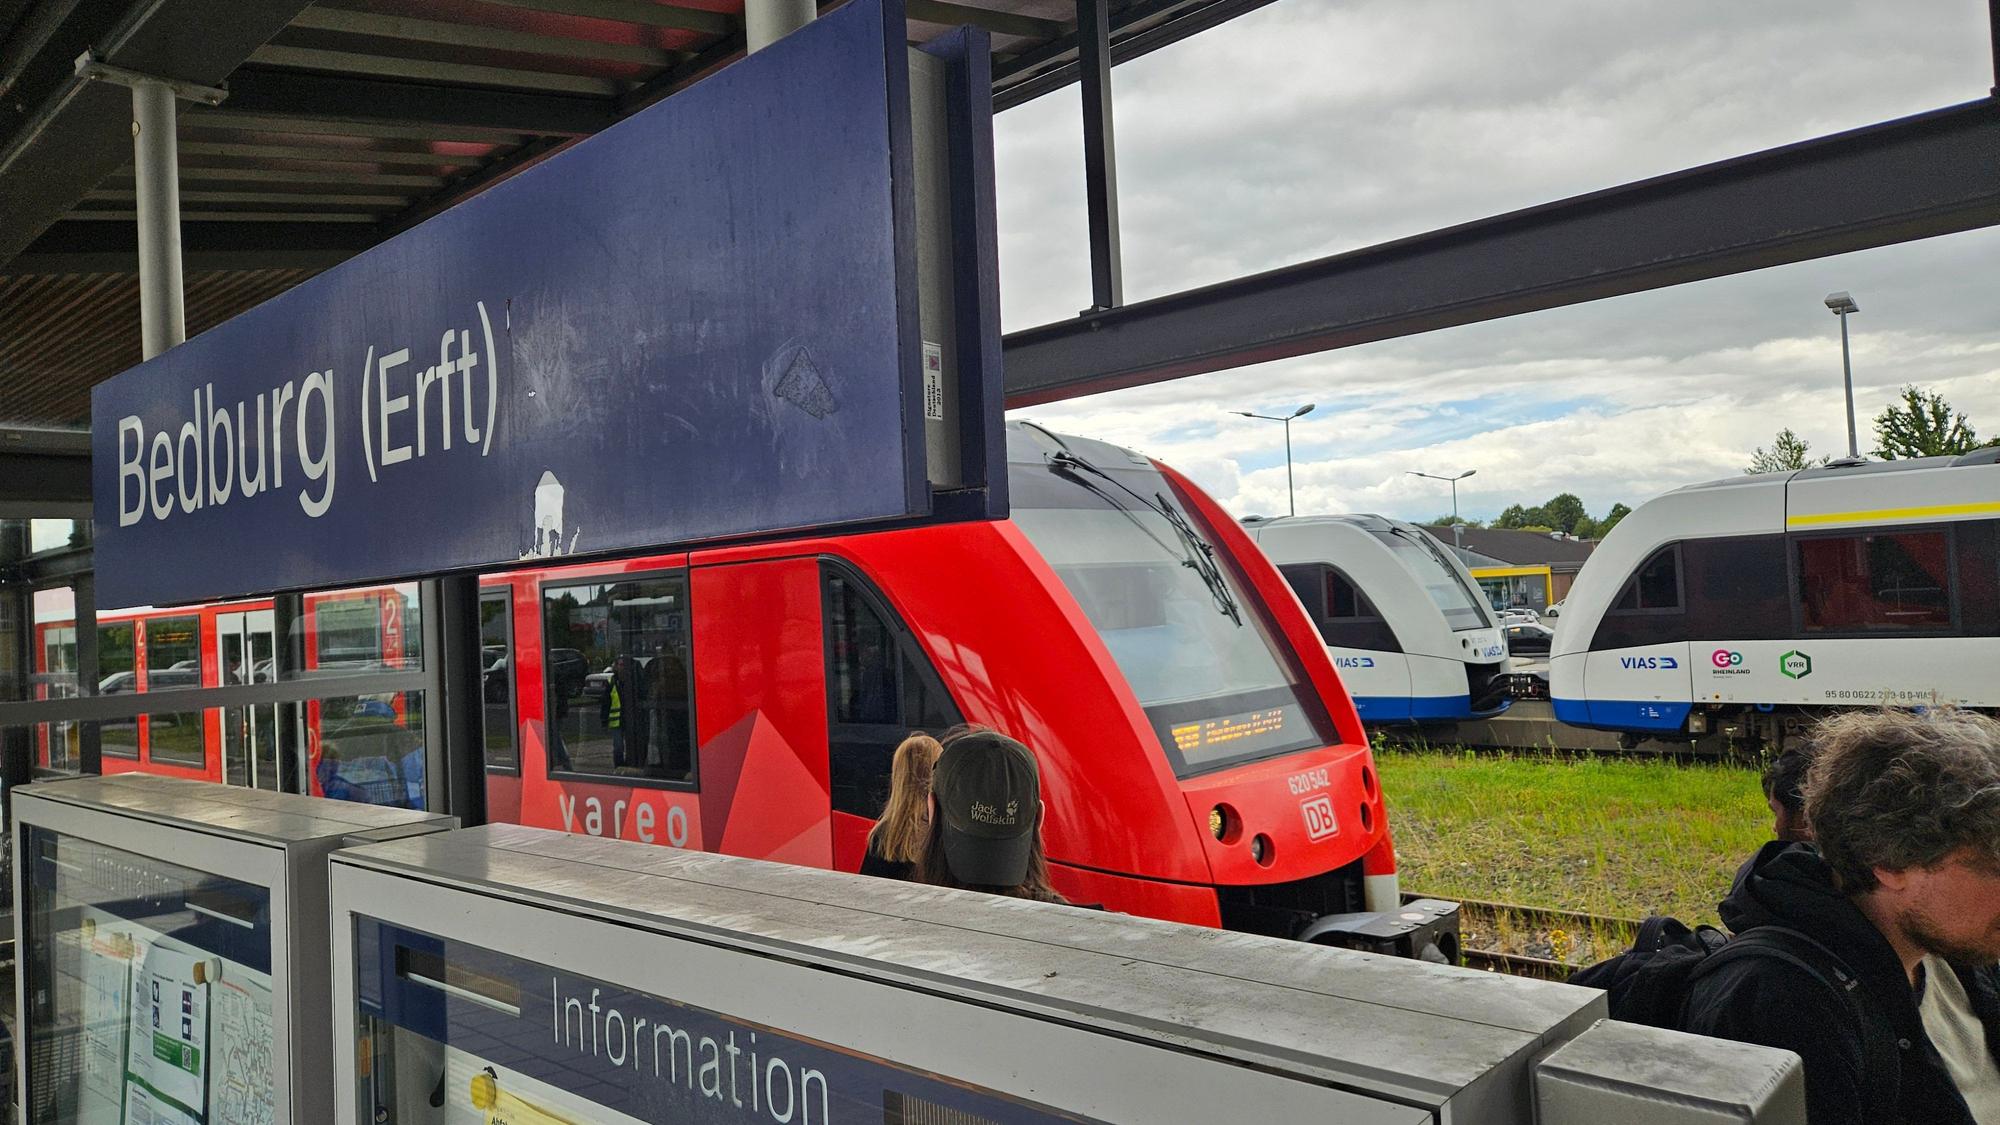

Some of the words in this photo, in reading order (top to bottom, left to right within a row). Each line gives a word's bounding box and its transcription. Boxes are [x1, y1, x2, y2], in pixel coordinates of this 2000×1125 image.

[118, 369, 336, 528] Bedburg
[361, 301, 498, 483] (Erft)
[385, 598, 398, 634] 2
[136, 620, 144, 646] 2
[1621, 657, 1657, 669] VIAS
[1825, 690, 1837, 698] 95
[1839, 690, 1851, 698] 80
[1852, 690, 1875, 699] 0622
[1289, 774, 1311, 795] 620
[1309, 769, 1331, 789] 542
[559, 794, 688, 848] vareo
[971, 801, 997, 815] Jack
[971, 810, 1015, 825] Wolfskin
[1306, 803, 1333, 833] DB
[552, 977, 829, 1125] Information
